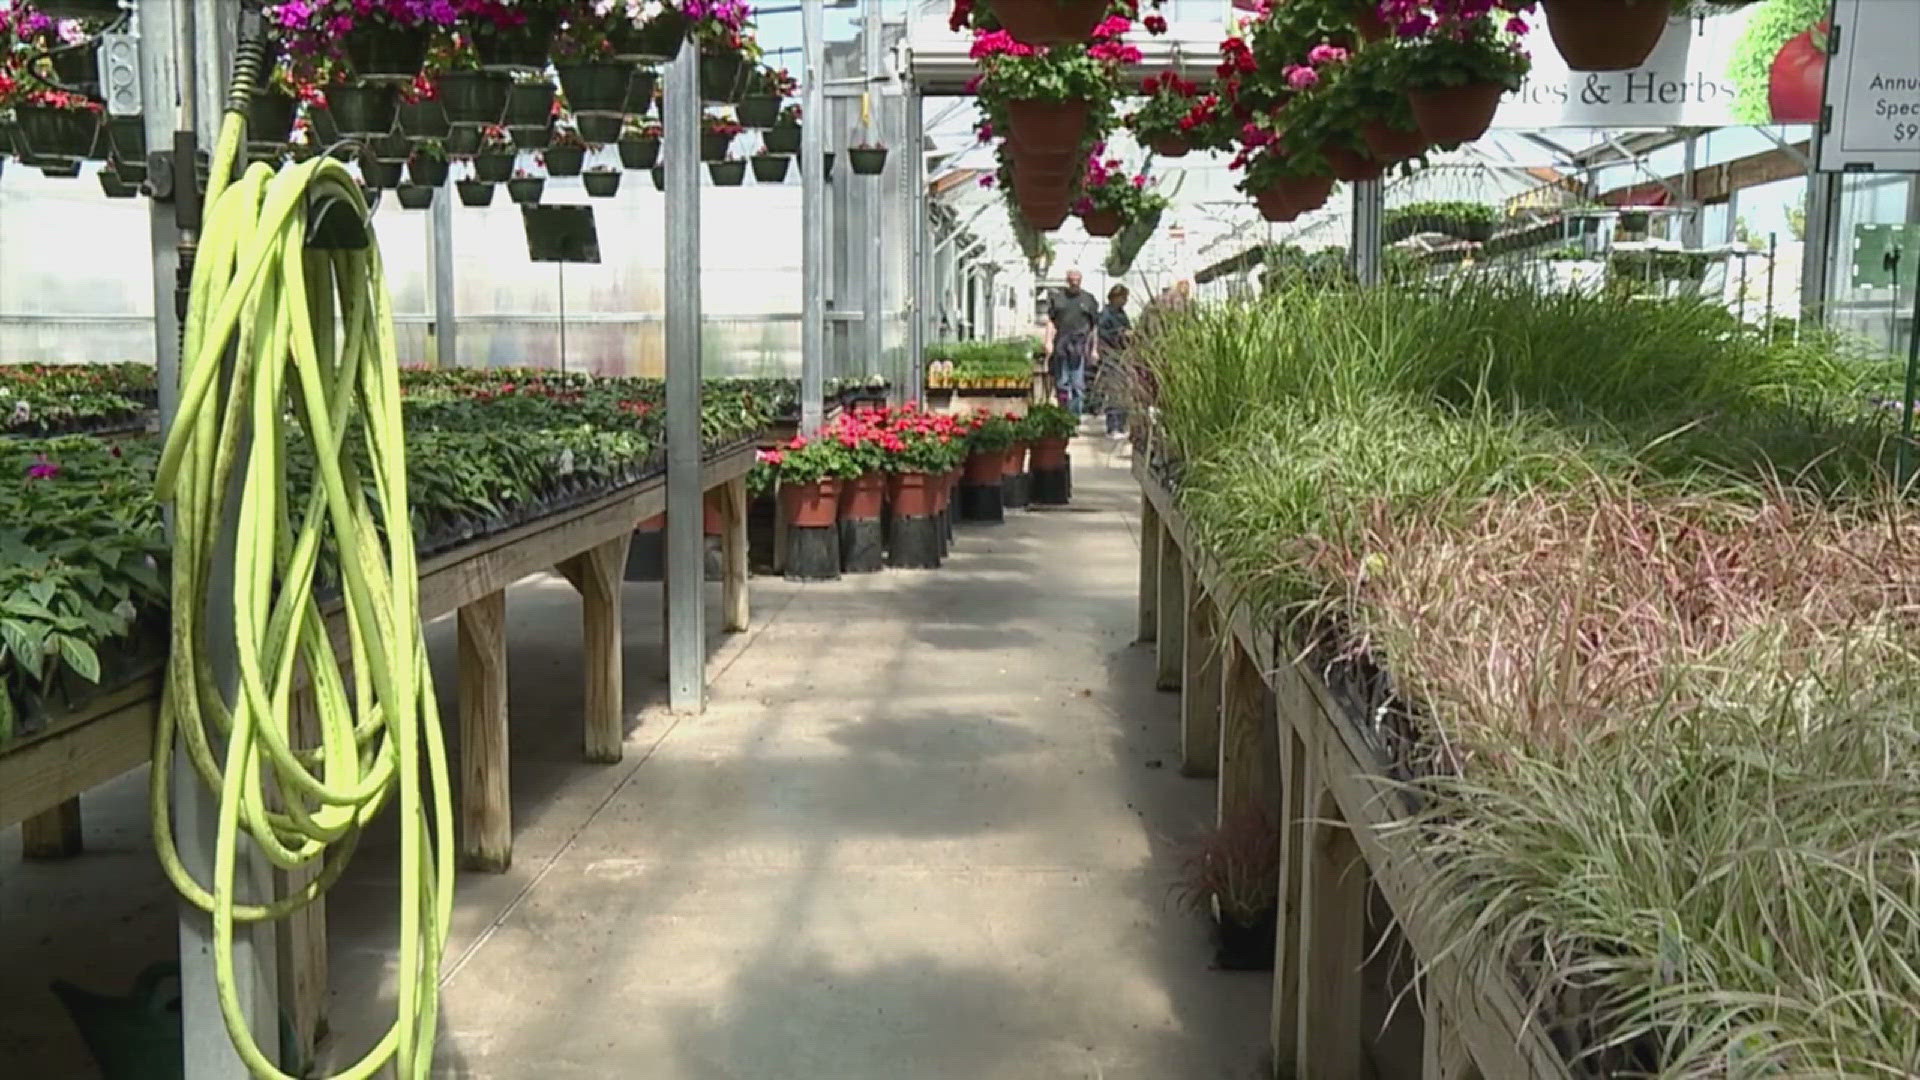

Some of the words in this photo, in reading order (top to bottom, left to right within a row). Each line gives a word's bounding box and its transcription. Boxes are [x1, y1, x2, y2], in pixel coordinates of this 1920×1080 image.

[1581, 73, 1612, 105] &
[1625, 72, 1736, 105] Herbs
[1869, 73, 1920, 90] Annu
